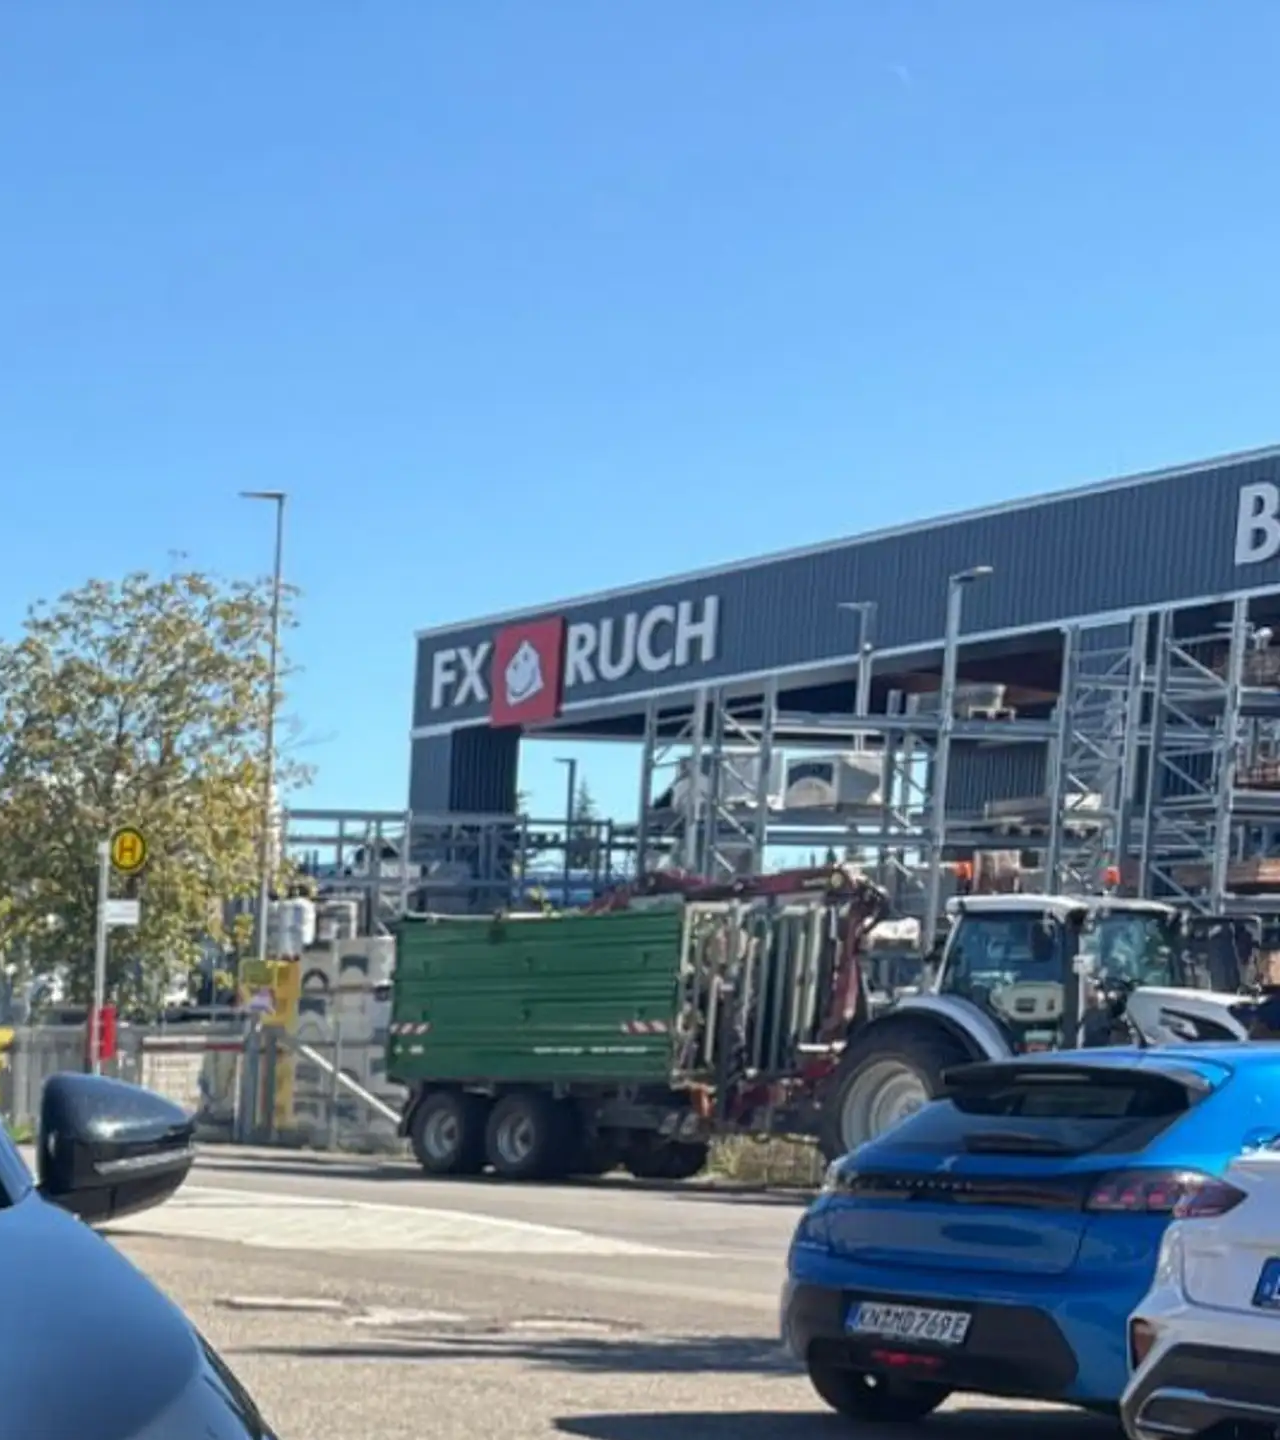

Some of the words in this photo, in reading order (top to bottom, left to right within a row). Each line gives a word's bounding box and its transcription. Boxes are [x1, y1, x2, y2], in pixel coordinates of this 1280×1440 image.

[431, 642, 492, 709] FX
[565, 596, 719, 687] RUCH
[119, 837, 138, 862] H
